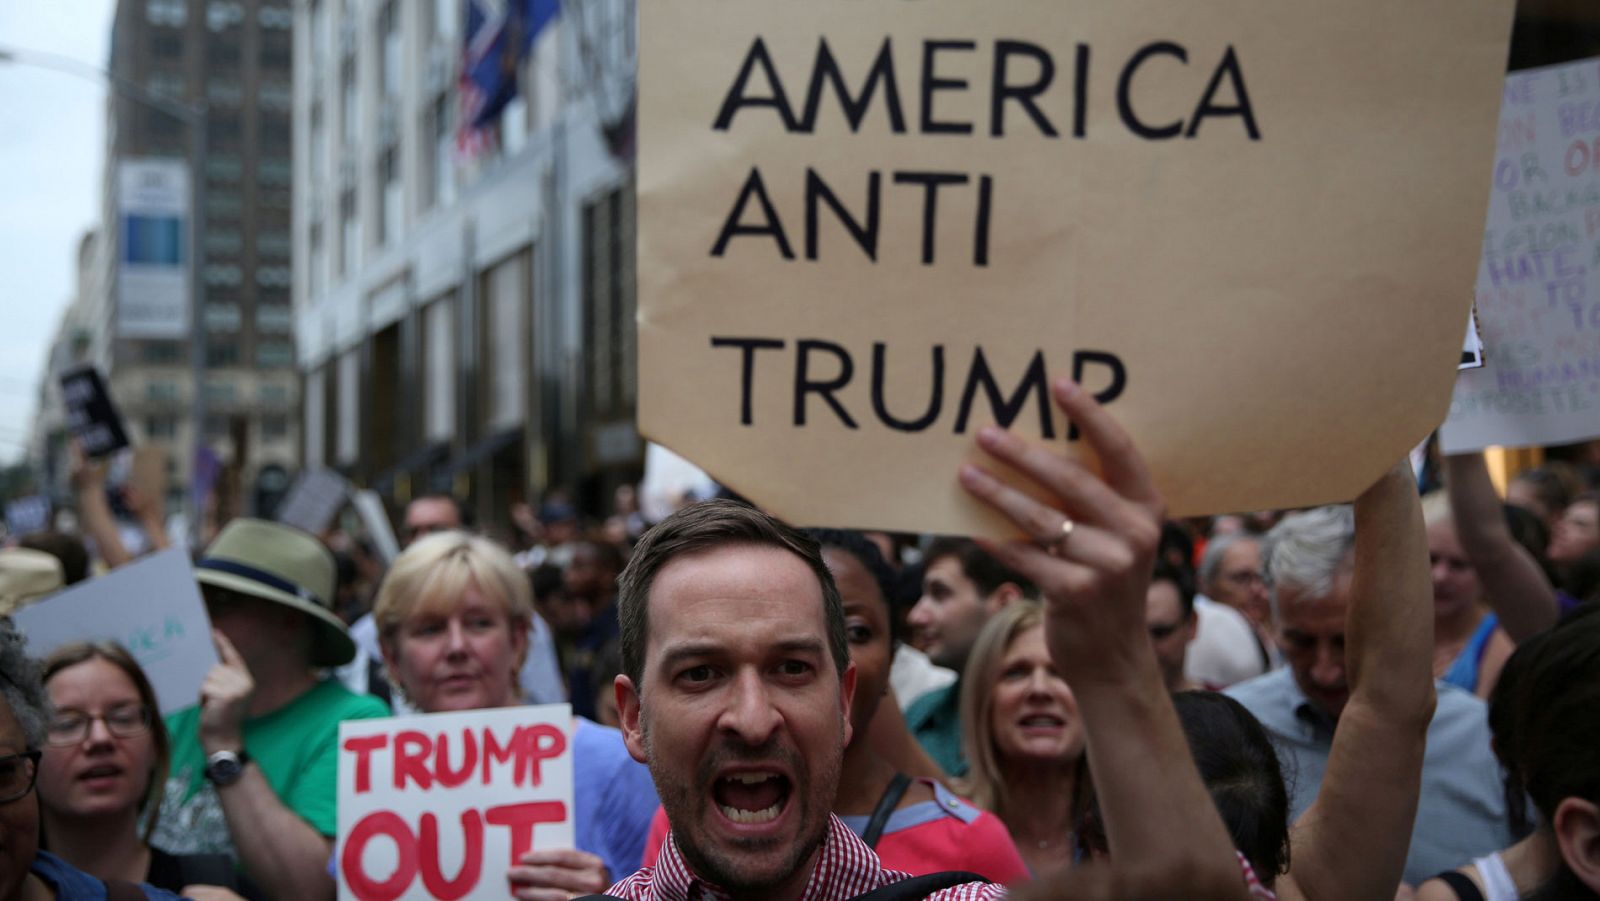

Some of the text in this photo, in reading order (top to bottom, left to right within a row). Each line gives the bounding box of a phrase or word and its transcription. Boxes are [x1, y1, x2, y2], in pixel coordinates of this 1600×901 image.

[713, 37, 1262, 142] AMERICA
[709, 168, 993, 267] ANTI
[711, 337, 1128, 440] TRUMP
[343, 723, 567, 794] TRUMP
[341, 800, 568, 901] OUT
